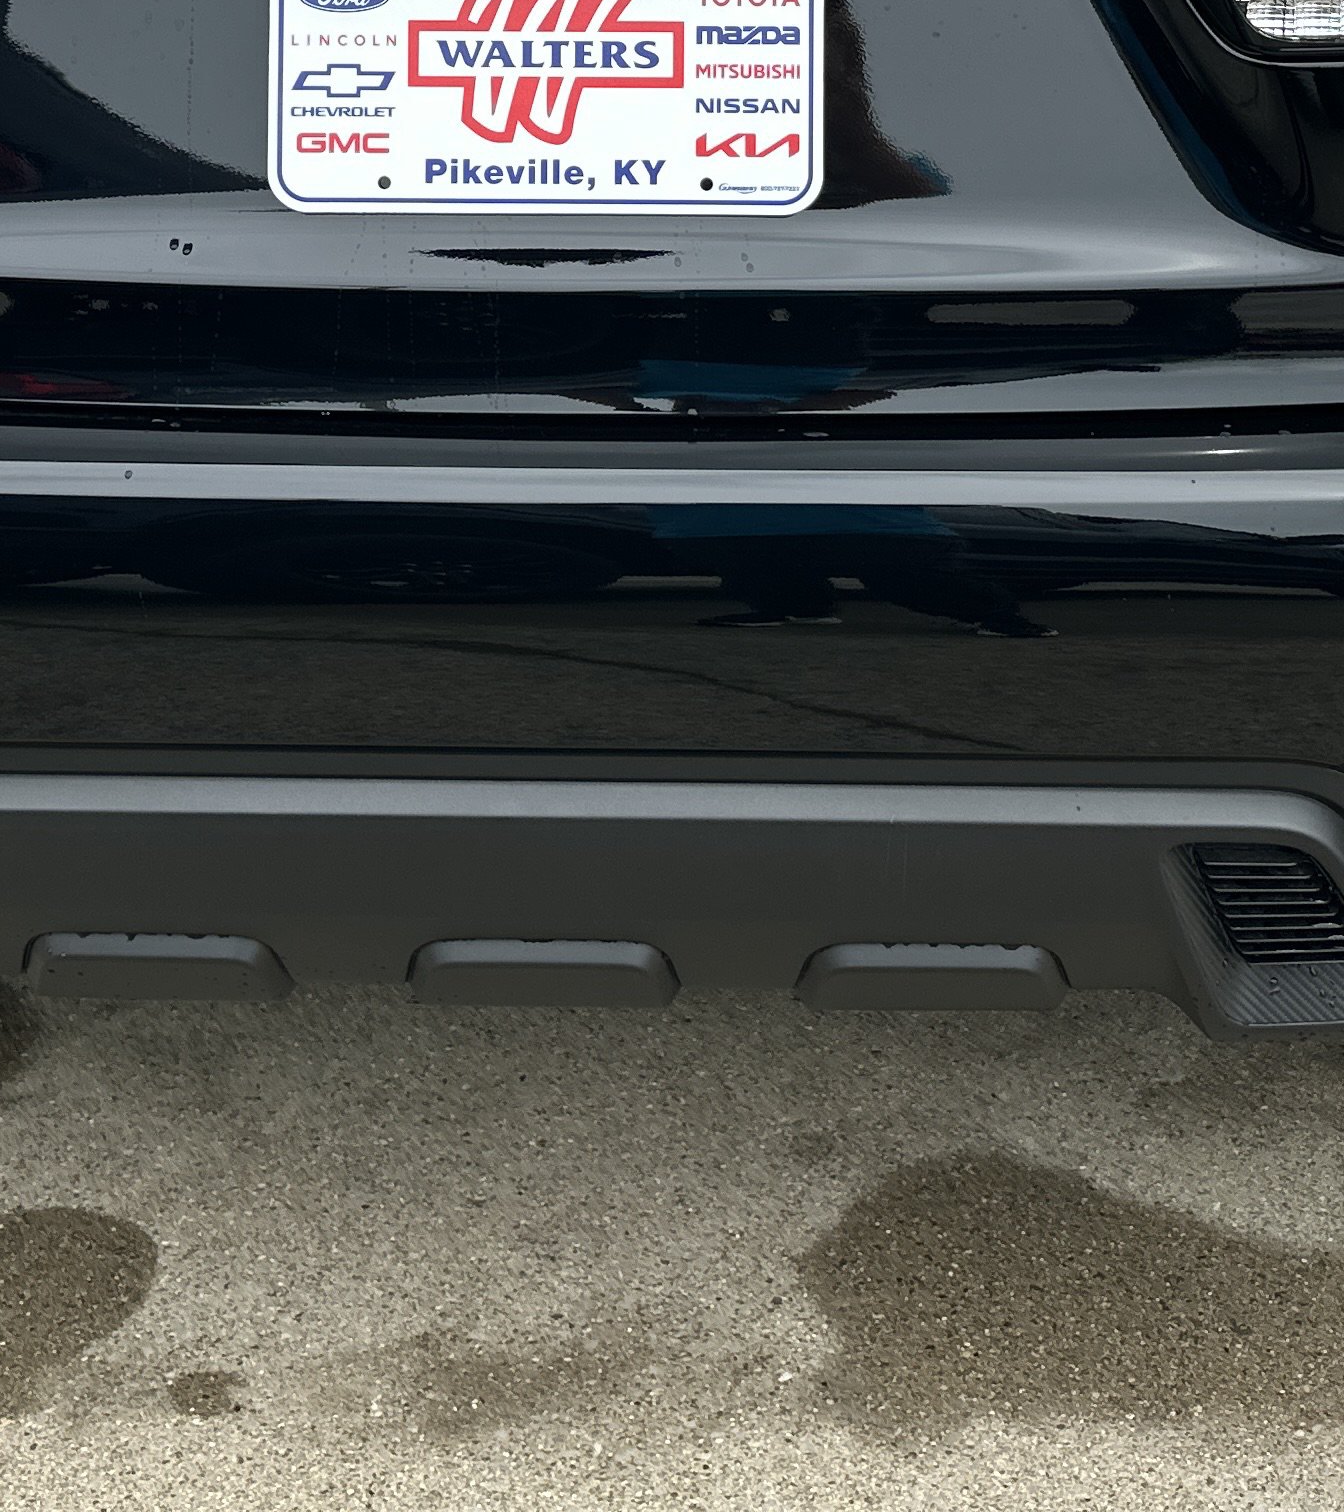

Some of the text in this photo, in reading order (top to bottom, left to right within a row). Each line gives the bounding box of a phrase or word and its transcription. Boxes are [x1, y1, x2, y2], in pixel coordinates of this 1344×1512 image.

[291, 34, 398, 47] LINCOLN
[436, 40, 661, 69] WALTERS
[695, 64, 801, 80] MITSUBISHI
[290, 106, 396, 118] CHEVROLET
[695, 98, 801, 114] NISSAN
[296, 132, 390, 154] GMC
[424, 158, 667, 191] Pikeville, KY
